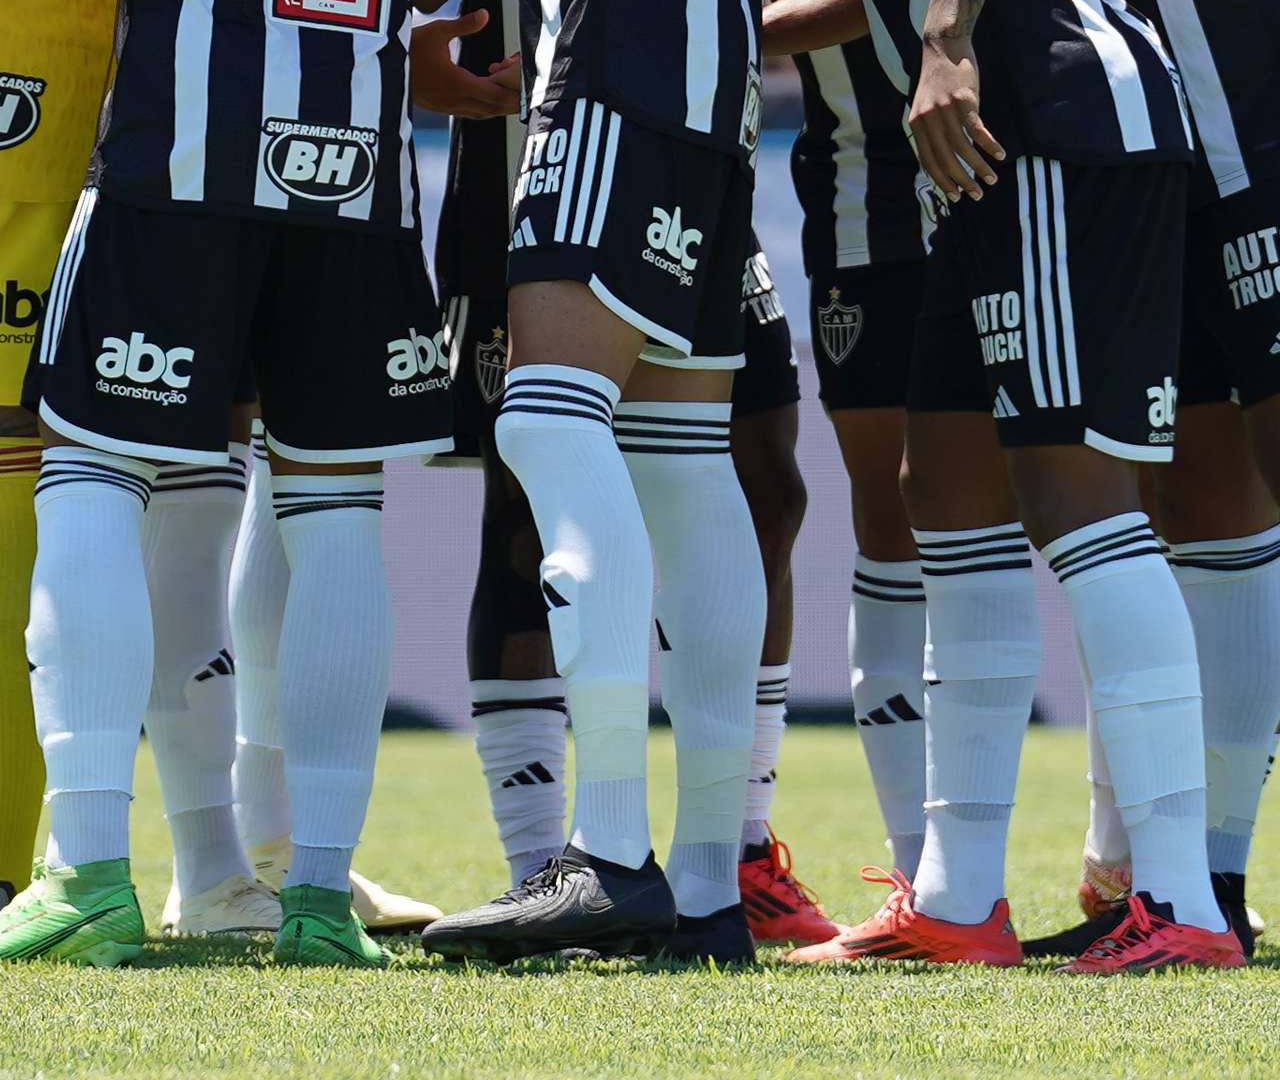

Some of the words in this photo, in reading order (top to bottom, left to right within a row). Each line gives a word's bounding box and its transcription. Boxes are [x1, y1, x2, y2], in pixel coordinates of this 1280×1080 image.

[266, 121, 376, 144] SUPERMERCADOS
[281, 140, 359, 186] BH
[823, 314, 854, 324] CAM
[95, 331, 195, 389] abc
[95, 378, 110, 393] da
[111, 384, 188, 406] construção
[389, 383, 408, 397] da
